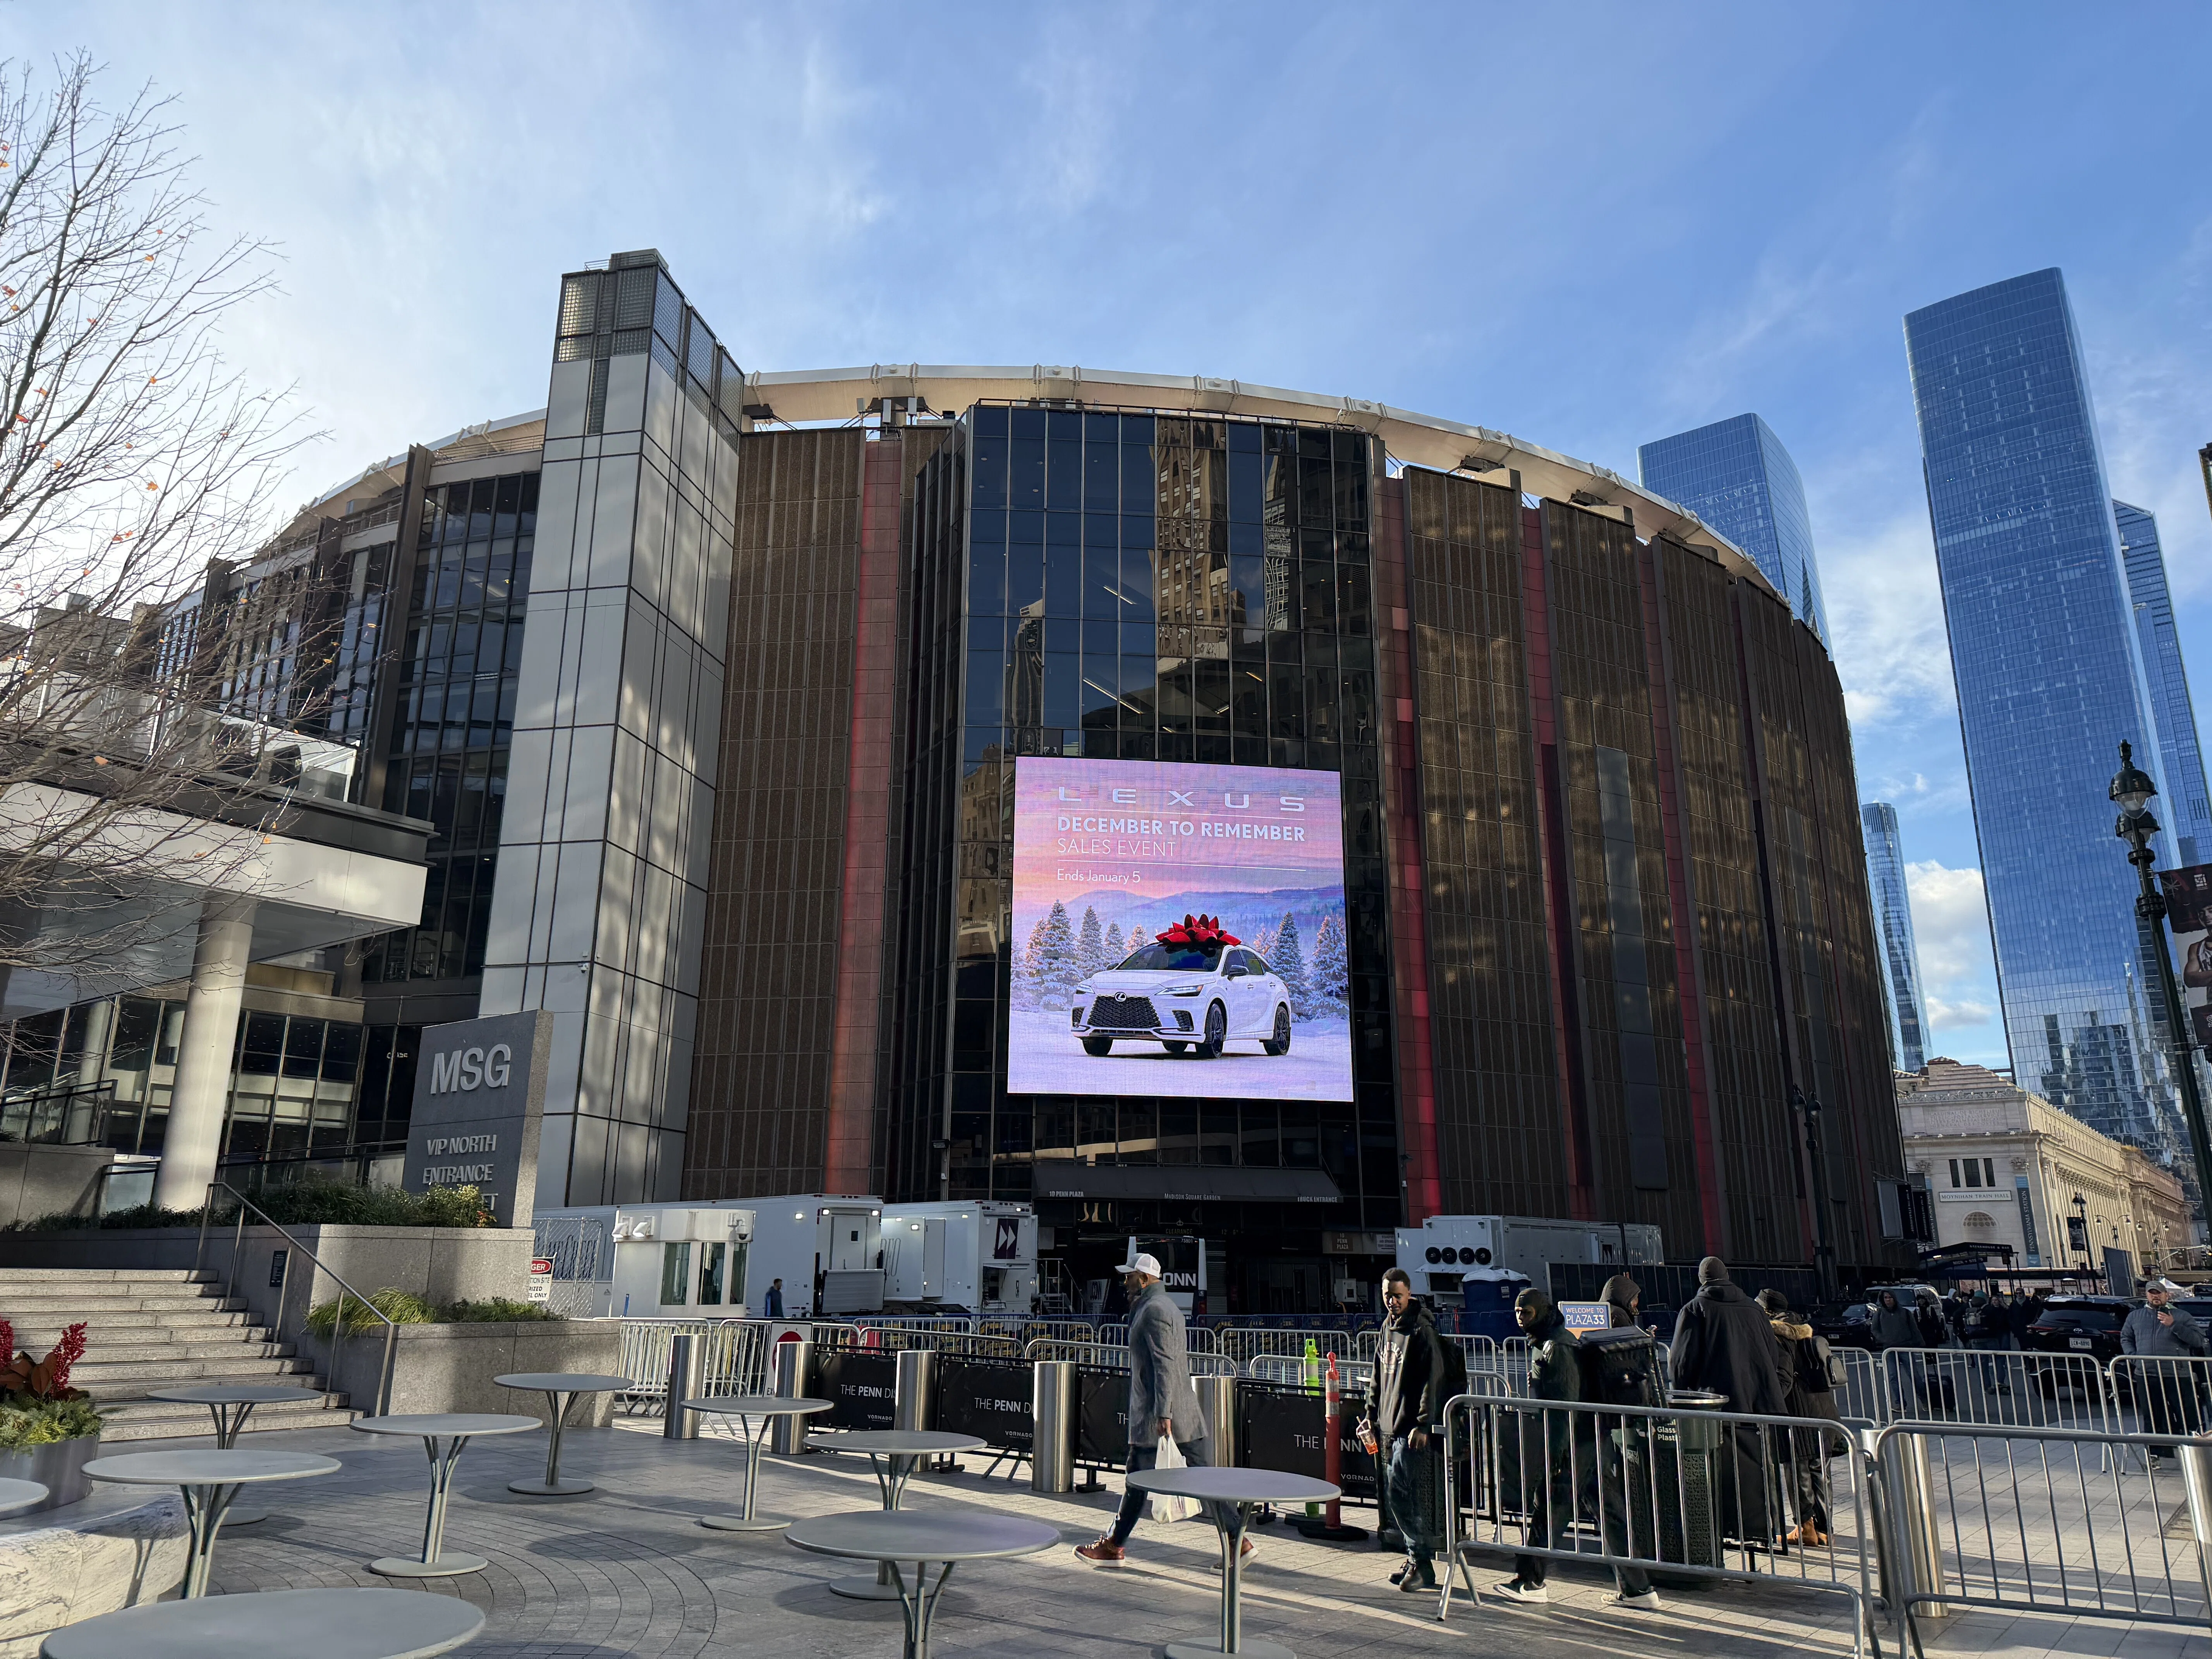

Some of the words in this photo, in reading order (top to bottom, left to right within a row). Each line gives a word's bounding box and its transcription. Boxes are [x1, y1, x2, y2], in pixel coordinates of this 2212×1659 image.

[1058, 786, 1305, 812] LEXUS
[1058, 816, 1163, 835] DECEMBER
[1170, 820, 1194, 836] TO
[1201, 822, 1305, 842] REMEMBER
[1058, 838, 1111, 854] SALES
[1118, 840, 1176, 856] EVENT
[1058, 869, 1084, 881] Ends
[1086, 870, 1129, 884] January
[1133, 871, 1140, 883] 5
[430, 1044, 511, 1094] MSG
[427, 1139, 447, 1155] VIP
[449, 1135, 496, 1154] NORTH
[423, 1164, 494, 1184] ENTRANCE
[2025, 1214, 2035, 1252] PENNSYLVANIA
[1163, 1272, 1196, 1286] ONN
[840, 1384, 856, 1395] THE
[858, 1386, 882, 1398] PENN
[974, 1398, 992, 1410] THE
[994, 1400, 1021, 1412] PENN
[1117, 1412, 1129, 1425] TH
[1293, 1434, 1319, 1449] THE
[1341, 1473, 1374, 1482] VORNAD
